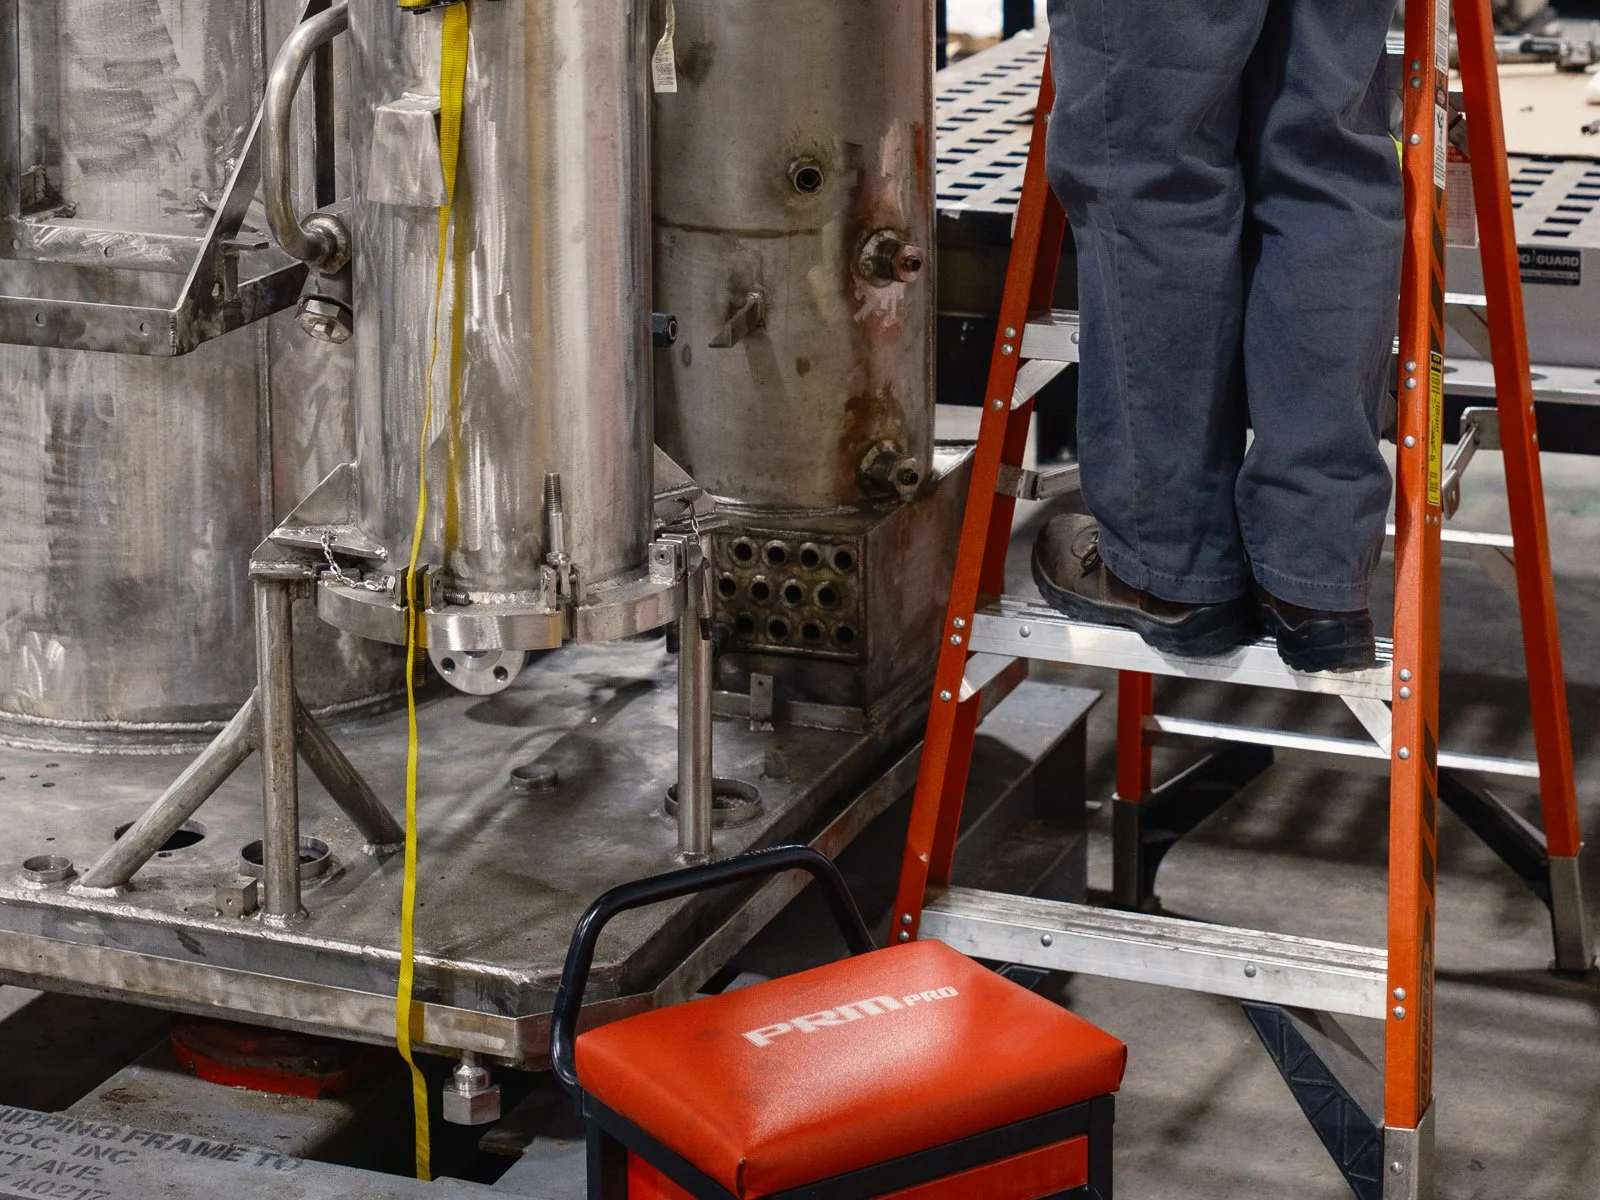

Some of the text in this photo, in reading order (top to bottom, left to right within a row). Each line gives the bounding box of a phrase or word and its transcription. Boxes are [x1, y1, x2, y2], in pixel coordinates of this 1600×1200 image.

[1536, 254, 1580, 267] GUARD
[901, 985, 960, 1008] PRO
[121, 1128, 249, 1163] FRAME
[254, 1150, 304, 1172] TO
